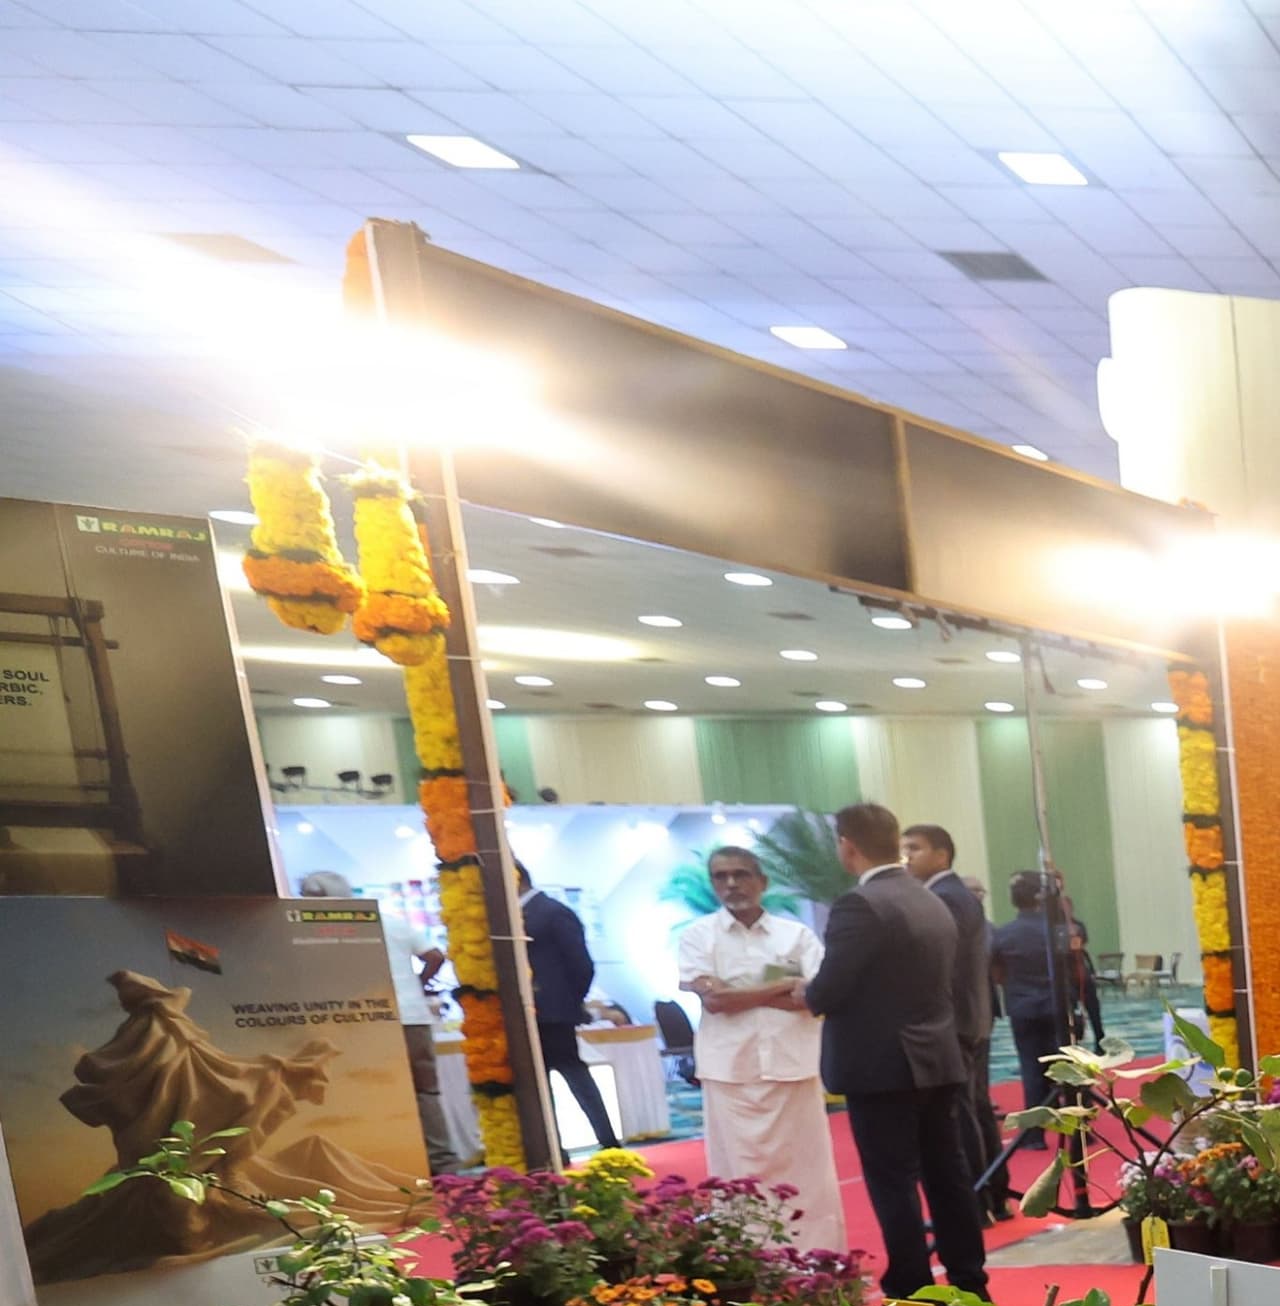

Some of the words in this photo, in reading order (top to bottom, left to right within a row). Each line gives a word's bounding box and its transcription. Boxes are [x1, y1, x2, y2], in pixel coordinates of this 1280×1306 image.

[101, 522, 207, 541] RAMRAJ
[95, 545, 146, 558] CULTURE
[151, 551, 165, 559] OF
[3, 670, 50, 682] SOUL
[302, 911, 377, 922] RAMRAJ
[232, 1001, 300, 1015] WEAVING
[303, 1001, 346, 1011] UNITY
[349, 1000, 362, 1010] IN
[364, 999, 391, 1010] THE
[235, 1014, 307, 1028] COLOURS
[310, 1014, 329, 1025] OF
